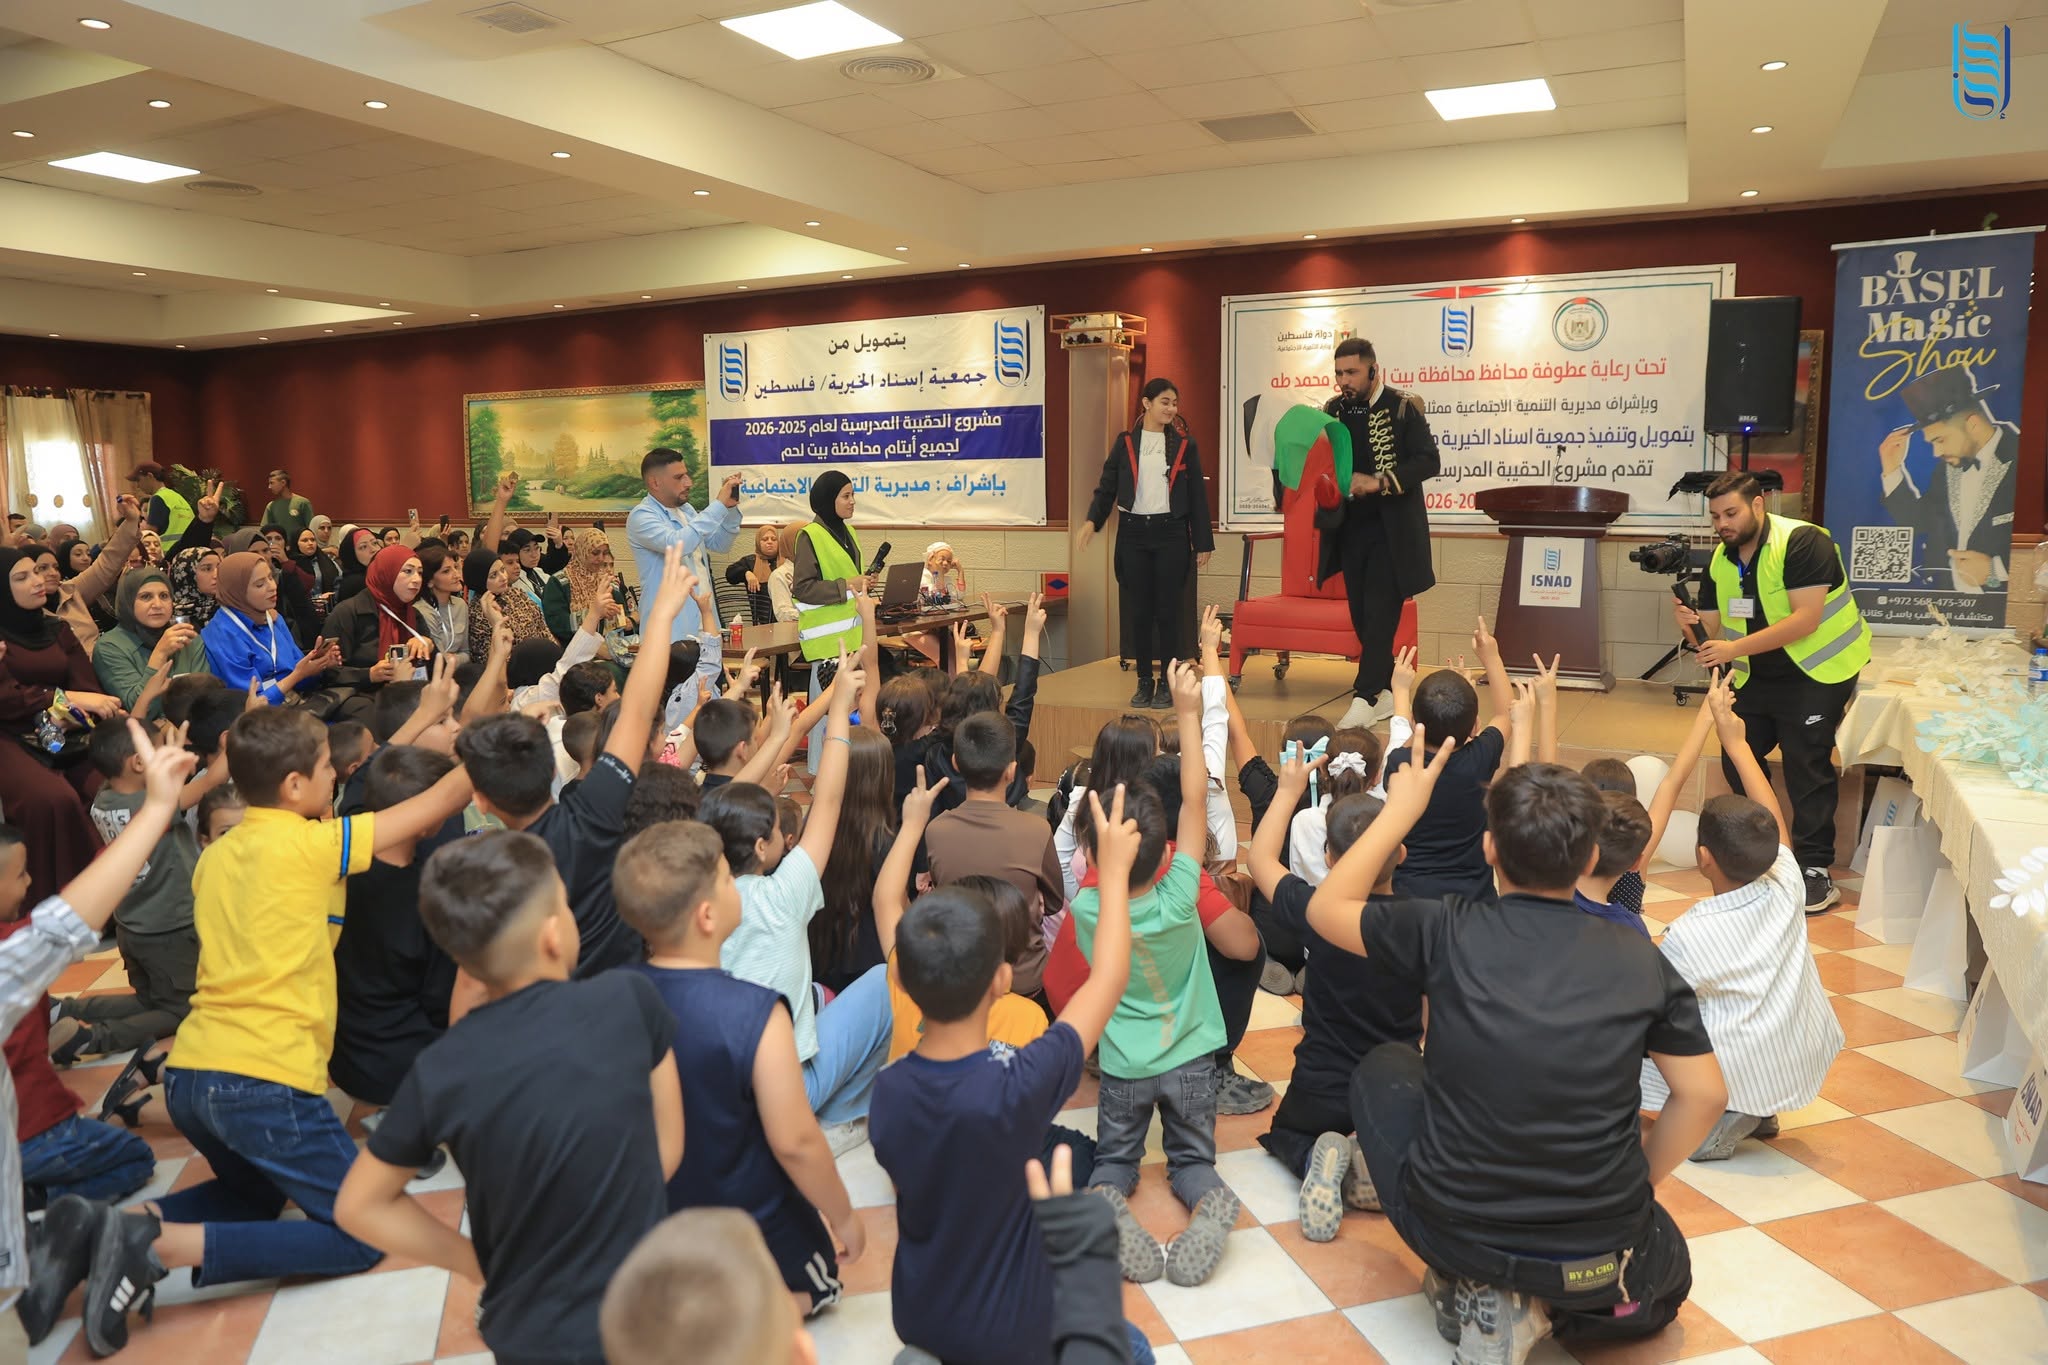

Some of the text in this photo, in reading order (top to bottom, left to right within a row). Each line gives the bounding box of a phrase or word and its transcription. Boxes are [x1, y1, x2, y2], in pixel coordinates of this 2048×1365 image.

[1858, 264, 2005, 308] BASEL
[1867, 302, 1992, 343] Magic
[828, 332, 906, 355] بتمويل من
[1277, 329, 1333, 342] دولة فلسطين
[1591, 358, 1630, 382] رعاية
[1635, 357, 1667, 375] تحت
[1858, 317, 1997, 401] Show
[880, 370, 924, 392] إسناد
[929, 367, 987, 389] جمعية
[1271, 372, 1291, 388] طه
[1294, 375, 1330, 388] محمد
[1390, 367, 1414, 388] بيت
[1418, 364, 1475, 383] محافظة
[1479, 362, 1528, 381] محافظ
[1532, 360, 1587, 384] عطوفة
[754, 375, 815, 399] فلسطين
[1456, 399, 1512, 417] الاجتماعية
[1516, 397, 1556, 416] التنمية
[1561, 397, 1601, 415] مديرية
[1605, 393, 1658, 414] وبإشراف
[745, 409, 1002, 437] مشروع الحقيبة المدرسية لعام 2026-2025
[1441, 428, 1491, 451] الخيرية
[1493, 427, 1533, 445] اسناد
[1535, 427, 1585, 449] جمعية
[1588, 426, 1637, 448] وتنفيذ
[1640, 425, 1695, 448] بتمويل
[781, 435, 960, 462] لجميع أيتام محافظة بيت لحم
[1496, 460, 1550, 482] الحقيبة
[1555, 457, 1607, 482] مشروع
[1611, 459, 1654, 482] تقدم
[740, 476, 812, 498] الاجتماعية
[874, 476, 931, 498] مديرية
[946, 473, 1006, 497] بإشراف
[1531, 574, 1572, 588] ISNAD
[2020, 1071, 2043, 1127] ISNAD
